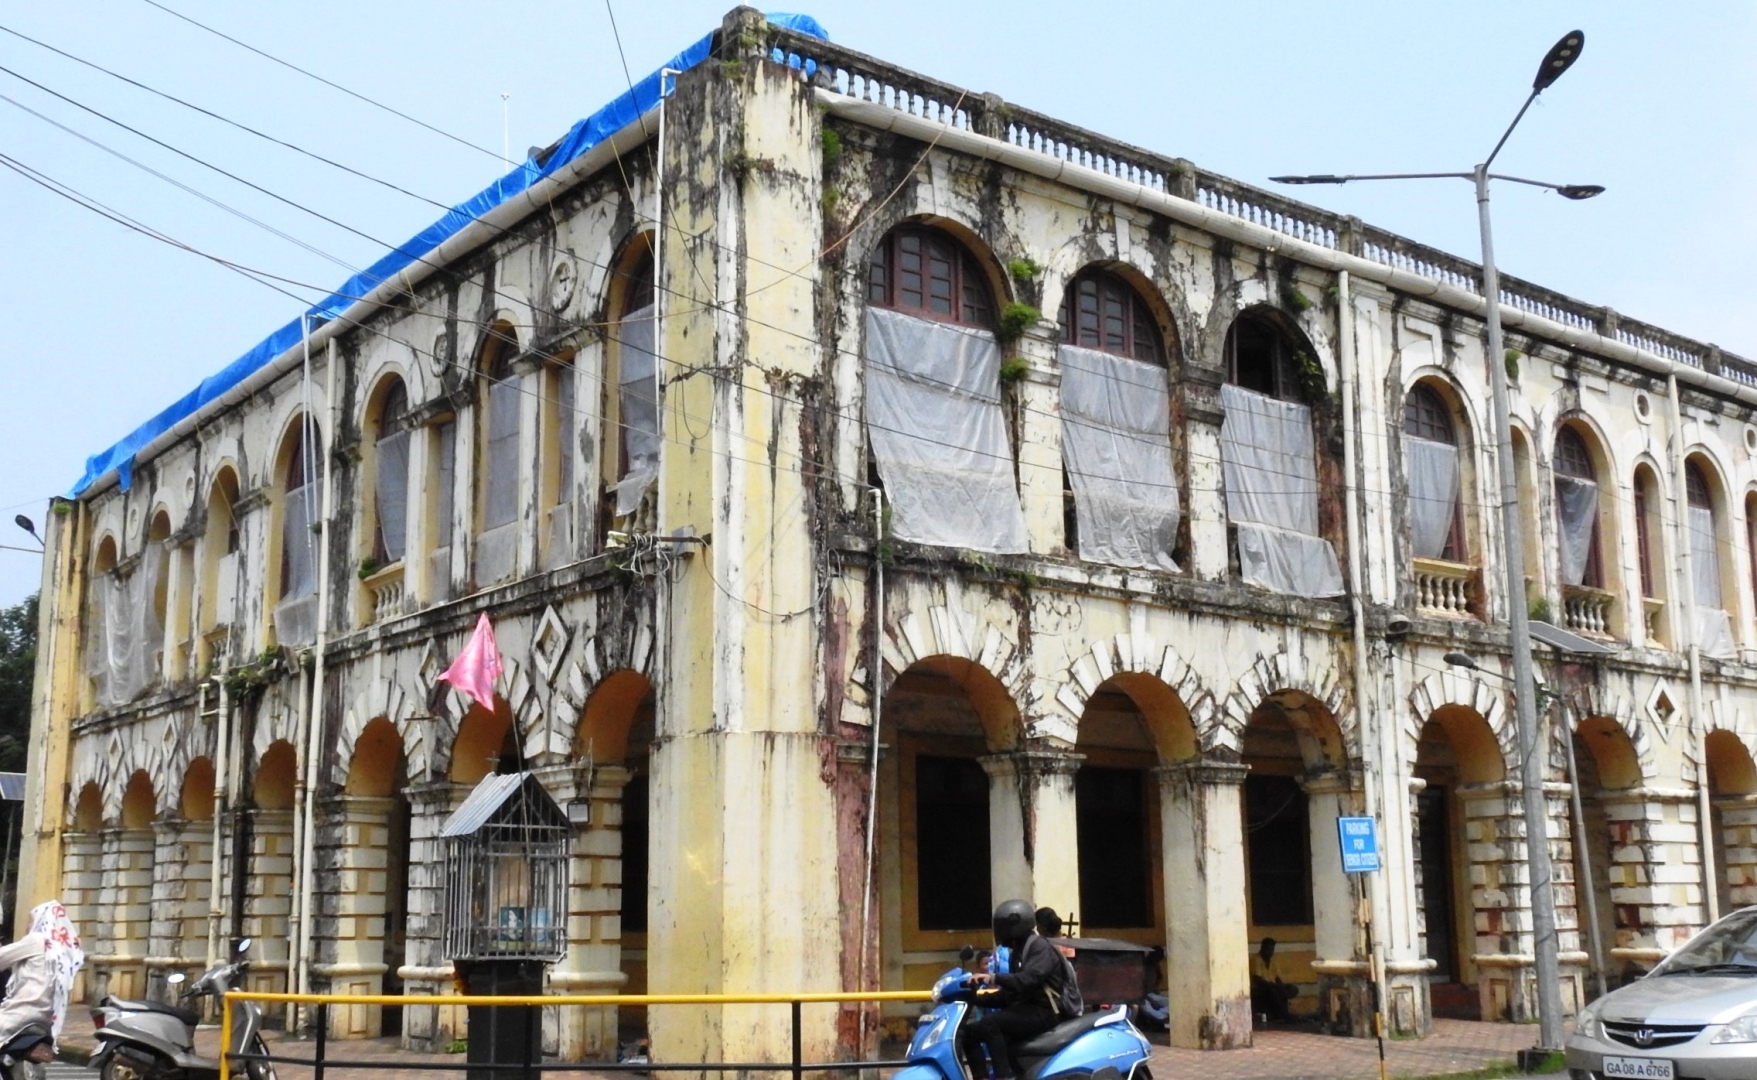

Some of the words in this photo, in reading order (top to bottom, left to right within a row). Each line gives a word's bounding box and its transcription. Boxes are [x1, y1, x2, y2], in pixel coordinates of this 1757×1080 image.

[1346, 822, 1370, 835] PARKING
[1353, 838, 1365, 850] FOR
[1346, 853, 1361, 866] SENIOR
[1606, 1062, 1622, 1074] GA
[1622, 1063, 1635, 1075] 08
[1637, 1064, 1644, 1075] A
[1645, 1065, 1670, 1077] 6766
